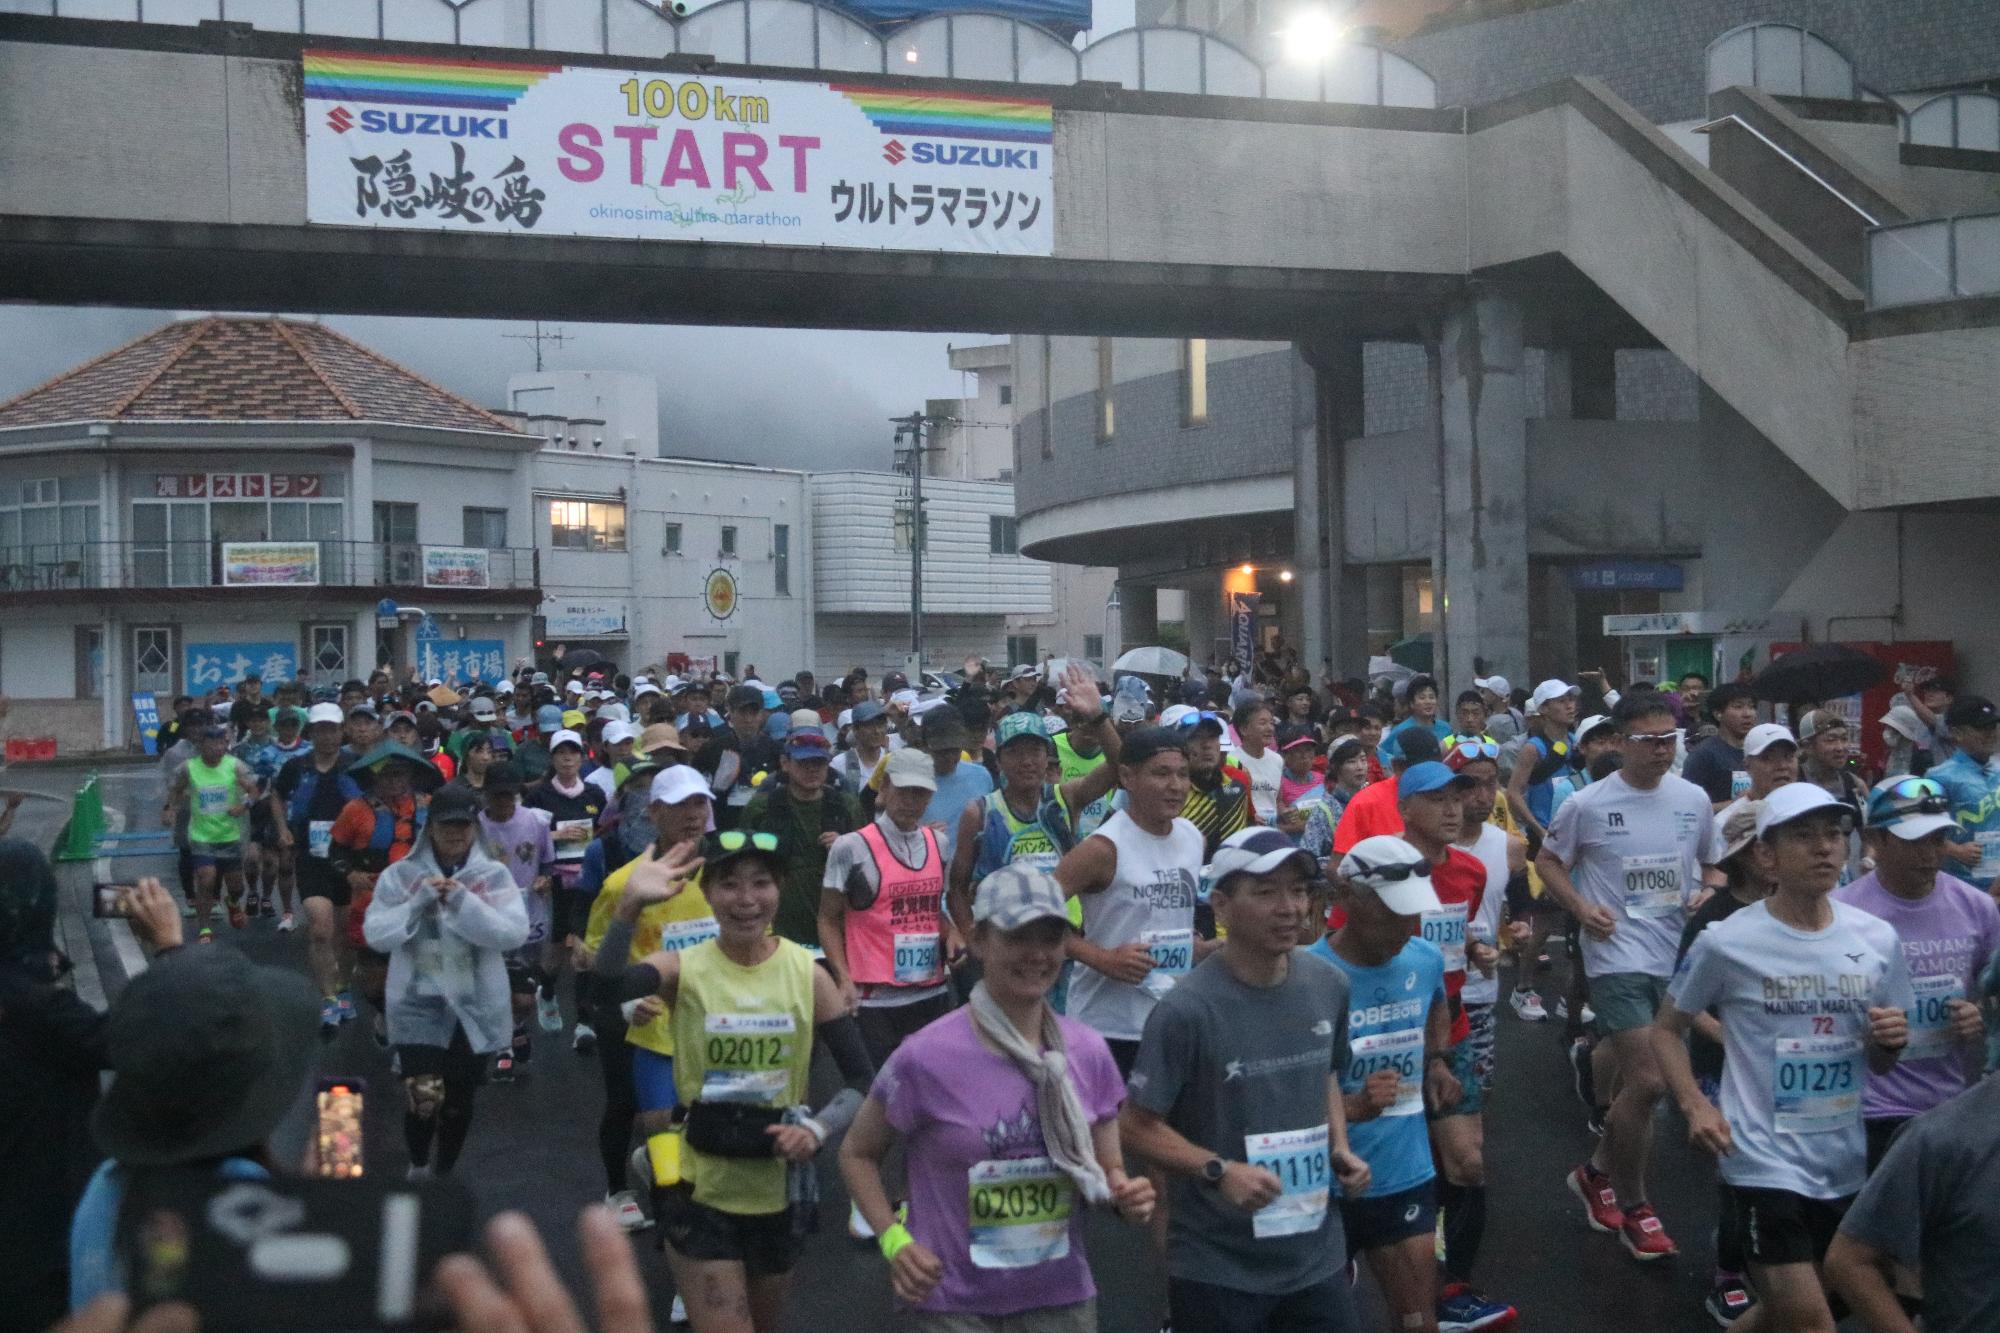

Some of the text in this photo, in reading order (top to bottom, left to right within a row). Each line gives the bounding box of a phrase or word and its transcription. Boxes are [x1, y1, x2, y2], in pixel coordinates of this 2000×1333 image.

[619, 78, 769, 124] 100km
[360, 109, 508, 140] SUZUKI
[557, 122, 821, 193] START
[911, 142, 1038, 170] SUZUKI
[724, 211, 801, 227] marathon
[831, 179, 1041, 232] ウルトラマラソン
[191, 652, 293, 686] お土産
[1152, 868, 1179, 883] THE
[1626, 868, 1675, 891] 01080
[1133, 882, 1180, 899] NORTH
[1146, 946, 1187, 969] 1260
[1349, 1003, 1391, 1028] OBE
[1811, 1016, 1834, 1035] 72
[708, 1037, 782, 1066] 02012
[1780, 1061, 1853, 1091] 01273
[974, 1183, 1058, 1219] 02030
